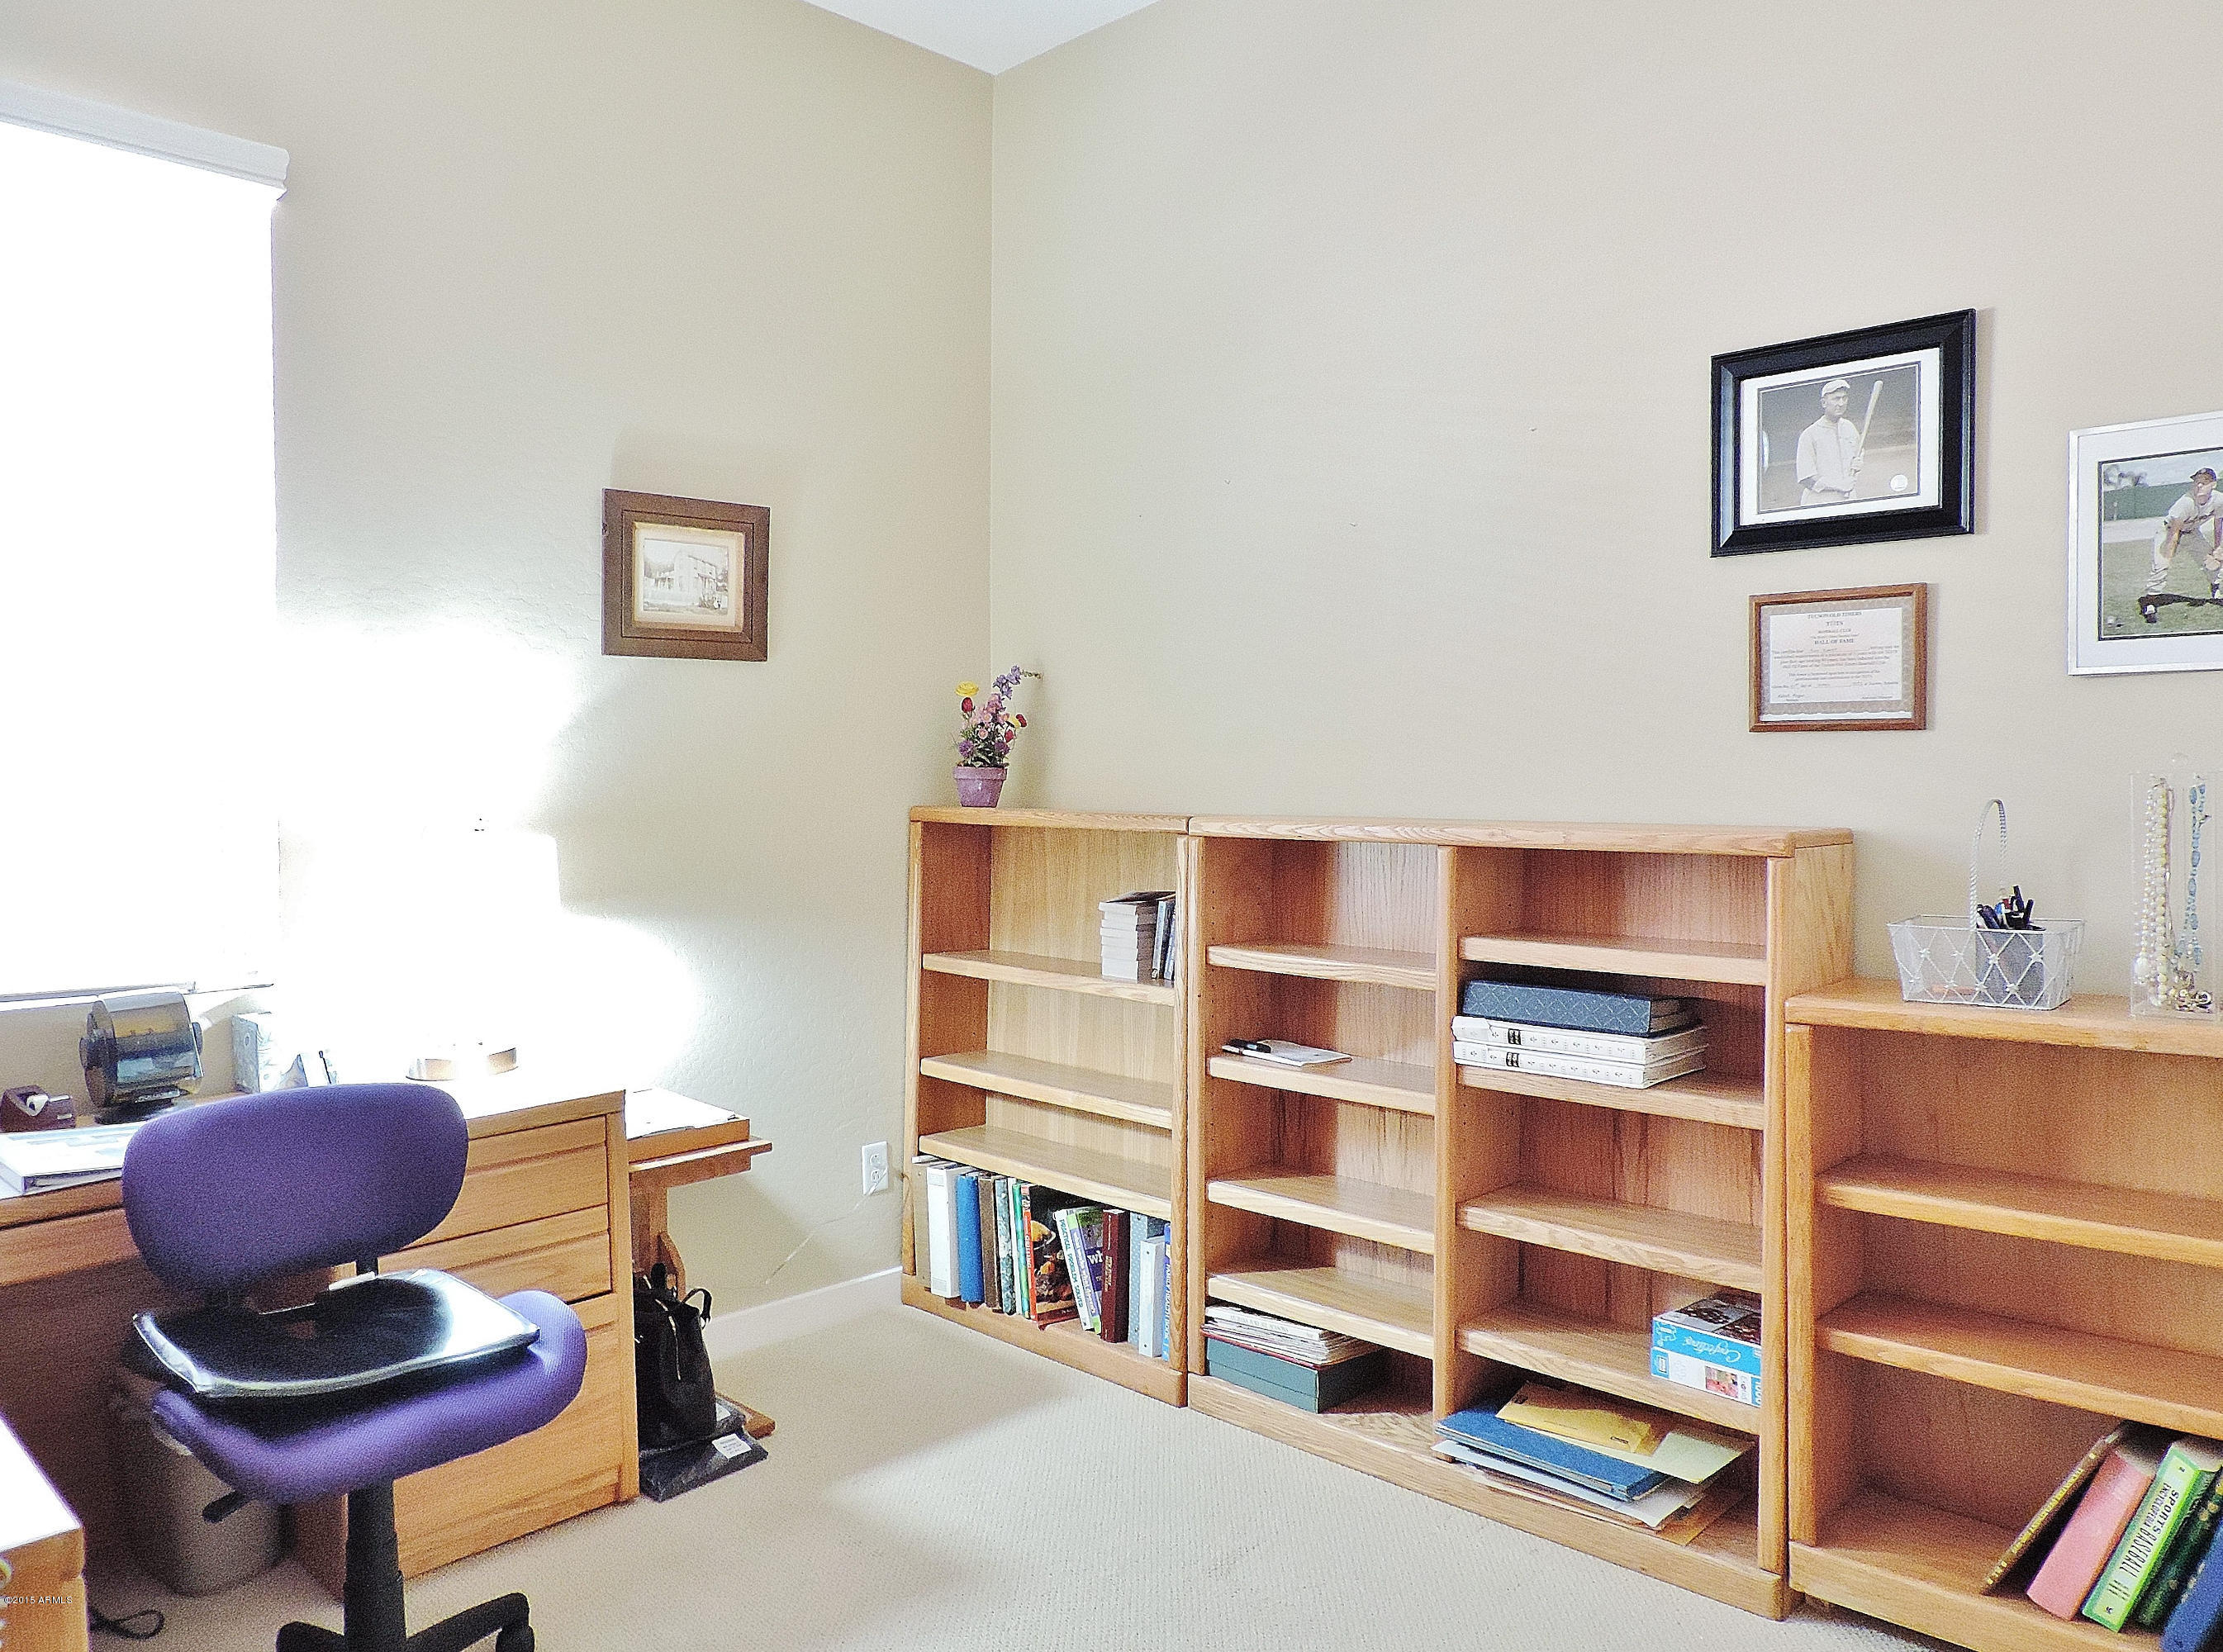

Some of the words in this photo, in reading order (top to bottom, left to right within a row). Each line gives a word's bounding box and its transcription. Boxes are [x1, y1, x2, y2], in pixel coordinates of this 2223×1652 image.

[1059, 1218, 1071, 1251] PRACTICAL
[1067, 1253, 1078, 1284] PROBLEM
[1074, 1284, 1084, 1308] SOLVER
[2145, 1483, 2172, 1527] ENCYCLOPEDIA
[2153, 1489, 2179, 1535] SPORTS
[2119, 1527, 2157, 1578] BASEBALL
